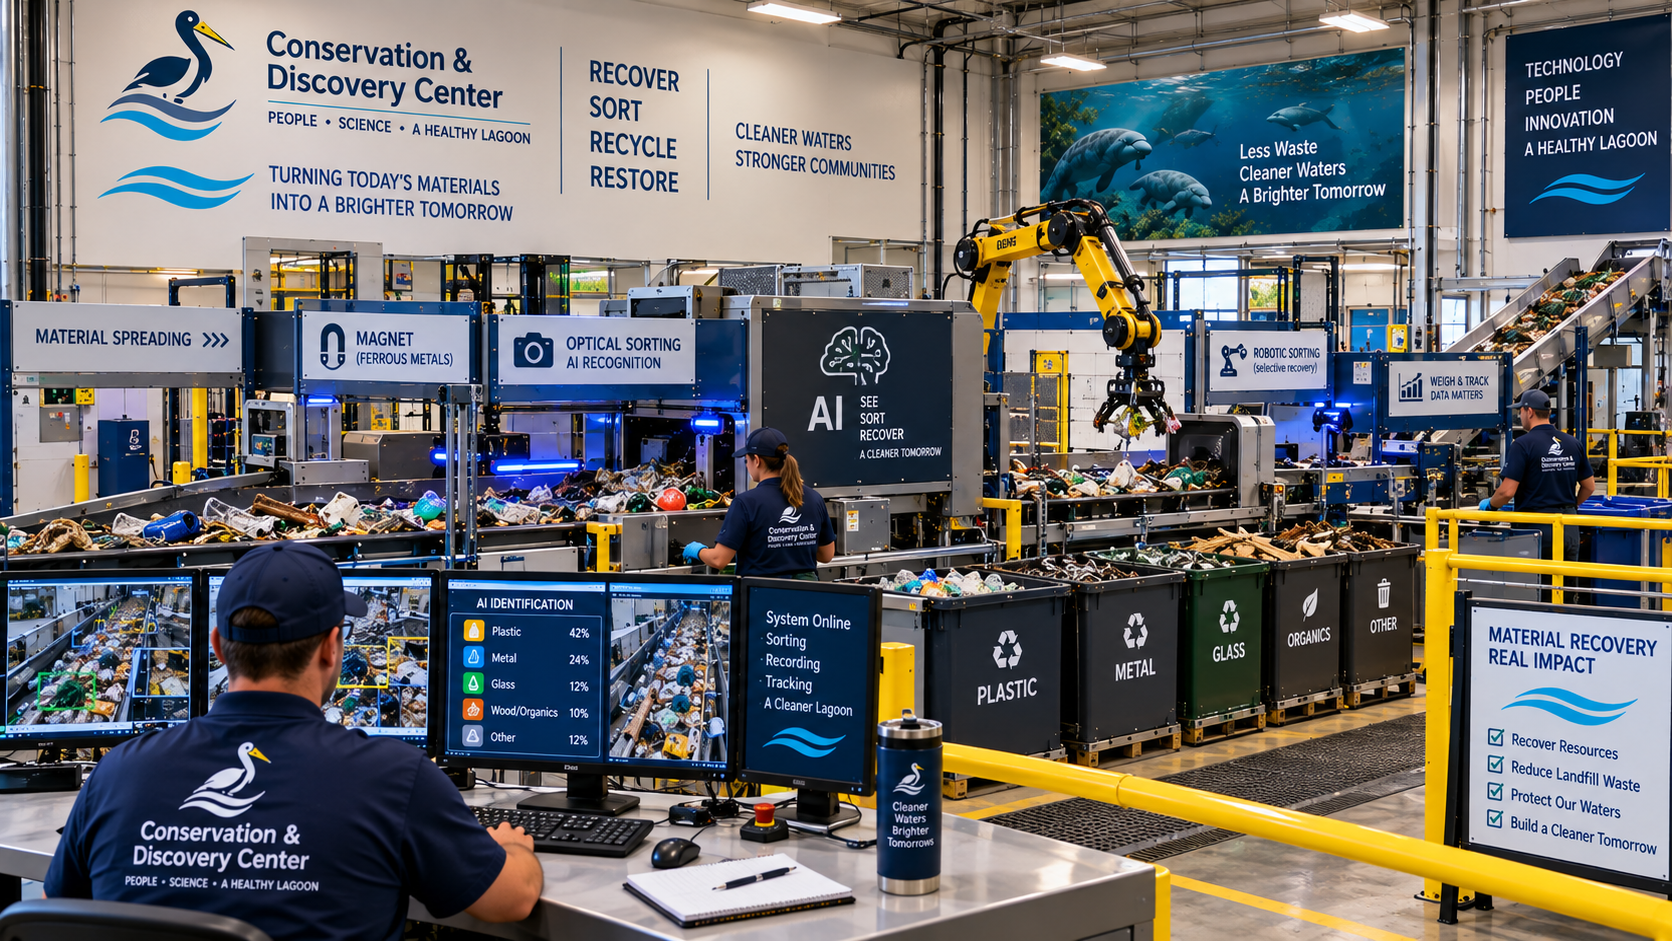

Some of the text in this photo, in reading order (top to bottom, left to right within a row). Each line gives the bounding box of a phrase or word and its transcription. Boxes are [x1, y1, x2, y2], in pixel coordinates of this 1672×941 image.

[267, 30, 473, 73] Conservation &
[1525, 51, 1623, 78] TECHNOLOGY
[268, 64, 503, 109] Discovery Center
[590, 60, 679, 92] RECOVER
[1526, 84, 1581, 105] PEOPLE
[589, 95, 642, 122] SORT
[268, 111, 530, 145] PEOPLE SCIENCE A HEALTHY LAGOON
[1525, 108, 1614, 131] INNOVATION
[590, 130, 677, 159] RECYCLE
[736, 122, 852, 151] CLEANER WATERS
[1524, 130, 1657, 156] A HEALTHY LAGOON
[1240, 140, 1318, 159] Less Waste
[736, 149, 895, 181] STRONGER COMMUNITIES
[1240, 161, 1346, 182] Cleaner Waters
[268, 165, 500, 196] TURNING TODAY'S MATERIALS
[591, 165, 679, 193] RESTORE
[1239, 183, 1386, 206] A Brighter Tomorrow
[271, 193, 513, 221] INTO A BRIGHTER TOMORROW
[36, 328, 191, 347] MATERIAL SPREADING
[356, 331, 414, 346] MAGNET
[566, 336, 681, 351] OPTICAL SORTING
[356, 351, 453, 367] (FERROUS METALS)
[566, 356, 661, 369] AI RECOGNITION
[1254, 347, 1320, 359] ROBOTIC SORTING
[1253, 362, 1318, 375] (selective recovery)
[1430, 376, 1489, 387] WEIGH & TRACK
[860, 395, 878, 408] SEE
[1431, 390, 1483, 401] DATA MATTERS
[807, 395, 842, 431] AI
[860, 412, 885, 424] SORT
[860, 428, 904, 441] RECOVER
[476, 597, 573, 610] AI IDENTIFICATION
[766, 610, 851, 630] System Online
[1370, 616, 1397, 634] OTHER
[492, 626, 590, 638] Plastic 42%
[766, 632, 806, 651] Sorting
[1287, 627, 1331, 647] ORGANICS
[1489, 626, 1657, 657] MATERIAL RECOVERY
[492, 653, 589, 665] Metal 24%
[1213, 642, 1245, 662] GLASS
[1489, 648, 1596, 674] REAL IMPACT
[766, 653, 820, 674] Recording
[1115, 658, 1156, 681] METAL
[491, 679, 589, 692] Glass 12%
[765, 674, 812, 695] Tracking
[977, 677, 1037, 705] PLASTIC
[491, 705, 589, 719] Wood/Organics 10%
[764, 697, 853, 718] A Cleaner Lagoon
[490, 732, 588, 745] Other 12%
[1512, 733, 1618, 760] Recover Resources
[1512, 760, 1640, 793] Reduce Landfill Waste
[892, 801, 929, 812] Cleaner
[1511, 788, 1621, 819] Protect Our Waters
[894, 813, 926, 824] Waters
[141, 820, 300, 844] Conservation &
[887, 836, 934, 848] Tomorrows
[892, 825, 929, 838] Brighter
[1511, 816, 1657, 855] Build a Cleaner Tomorrow
[133, 845, 310, 872] Discovery Center
[125, 875, 319, 891] PEOPLE SCIENCE A HEALTHY LAGOON
